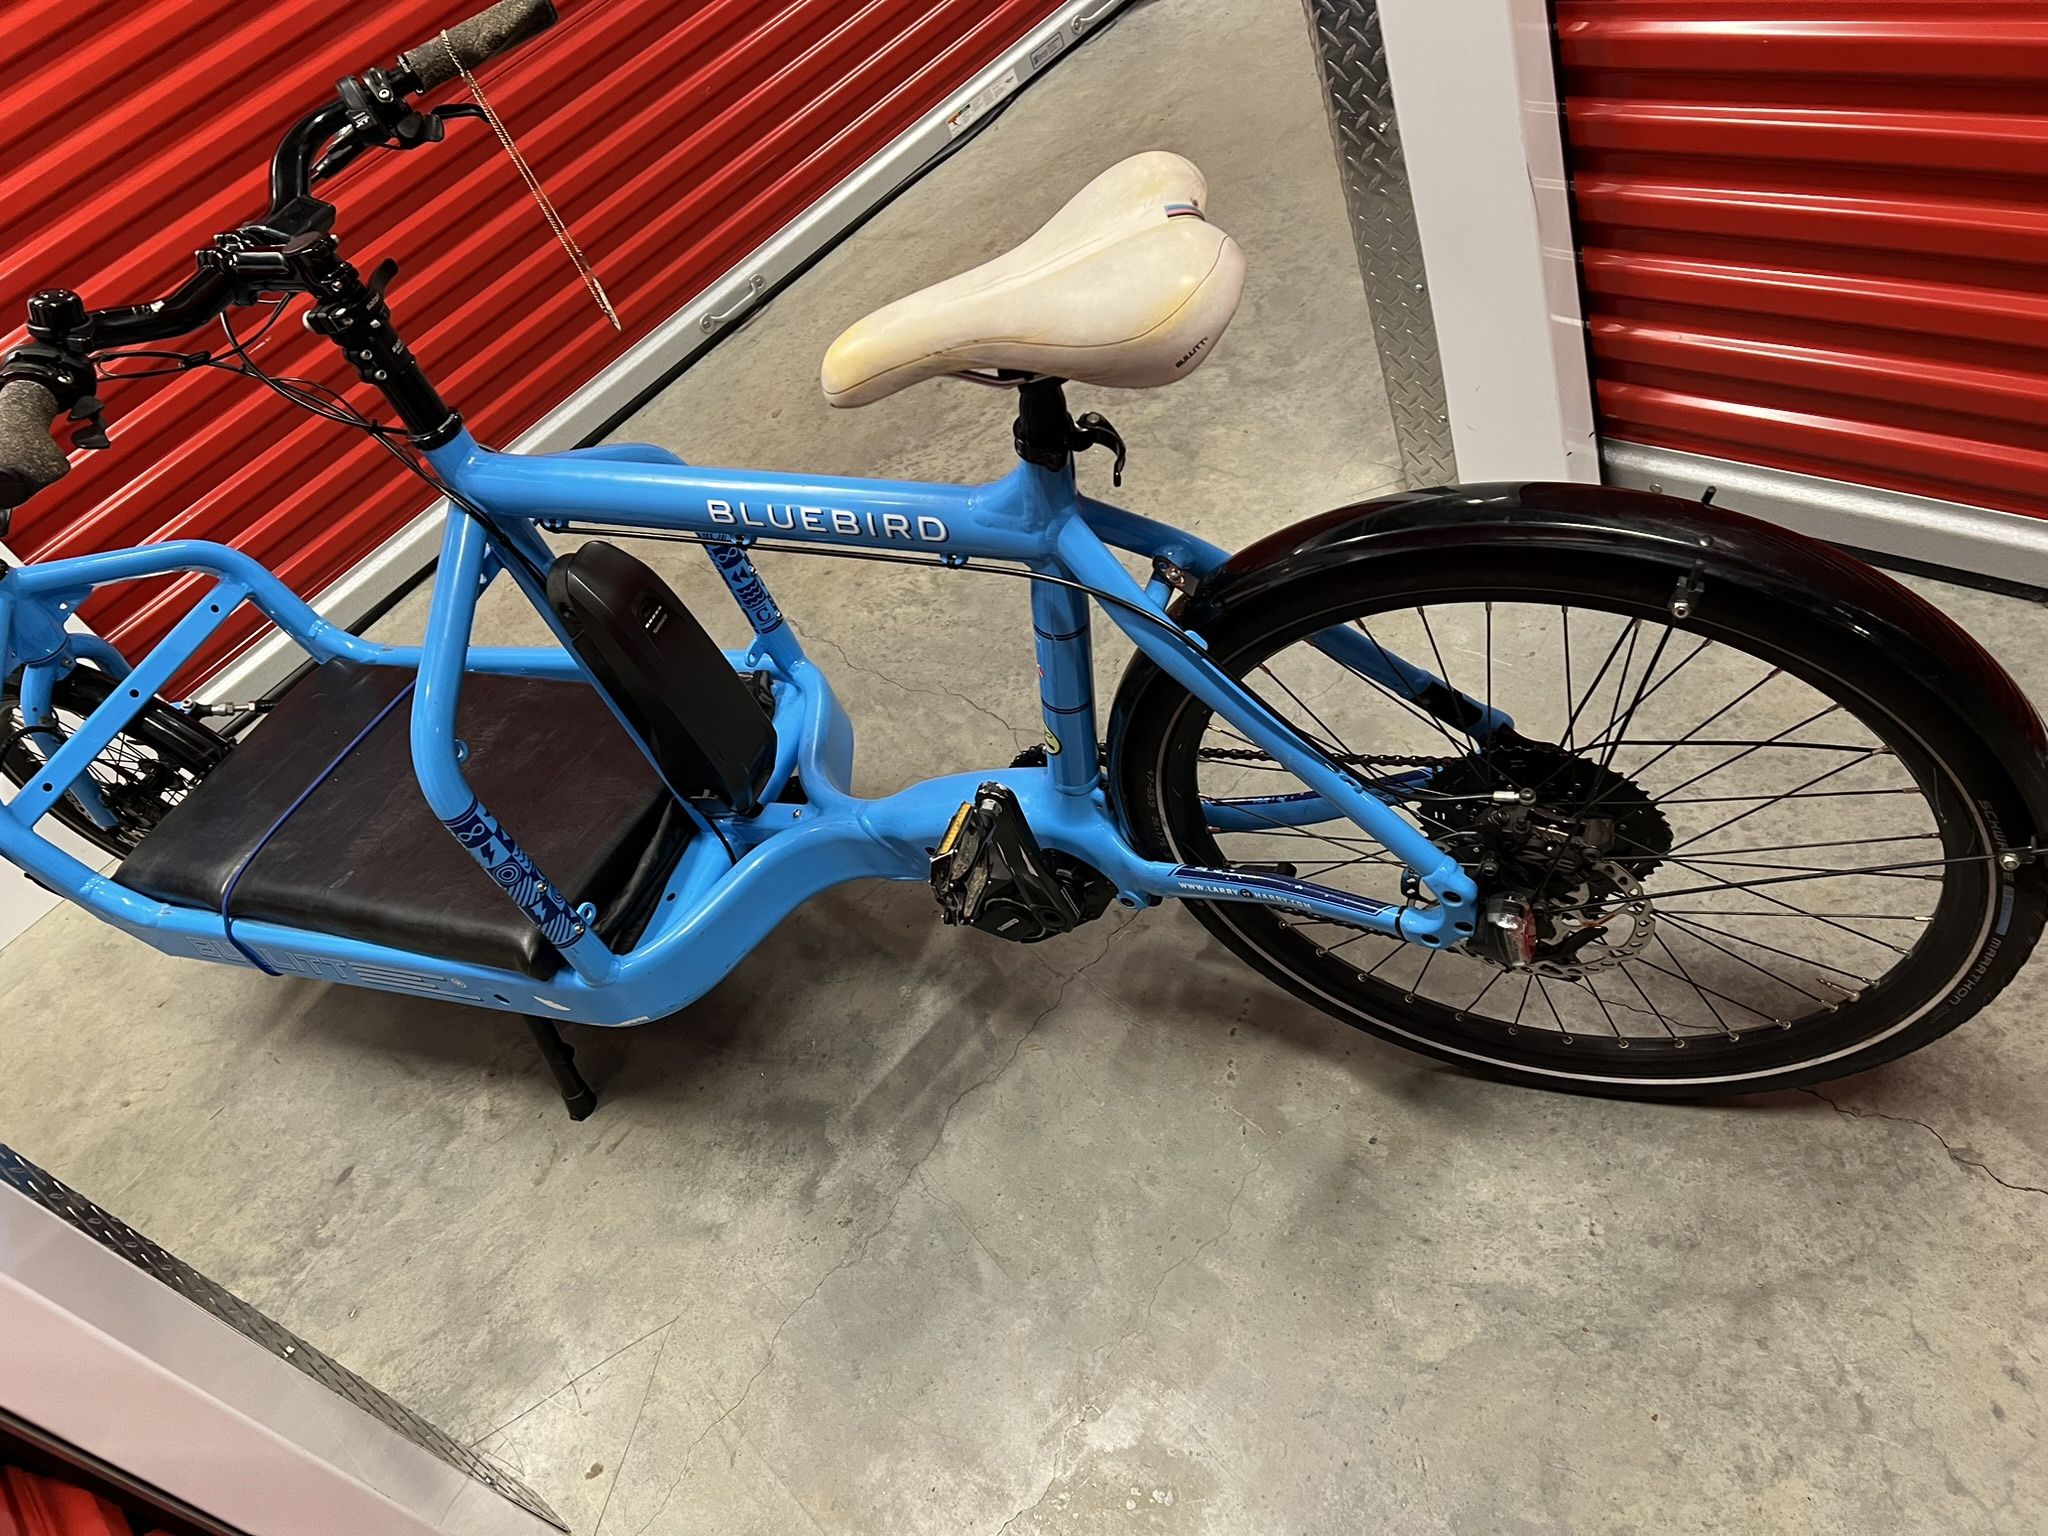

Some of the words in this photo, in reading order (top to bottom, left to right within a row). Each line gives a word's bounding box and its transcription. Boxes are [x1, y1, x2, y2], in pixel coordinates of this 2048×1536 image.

[706, 499, 950, 543] BLUEBIRD
[1978, 799, 2016, 884] SCHWAE
[184, 936, 349, 980] BULITT
[1950, 936, 2003, 1006] MARATHON
